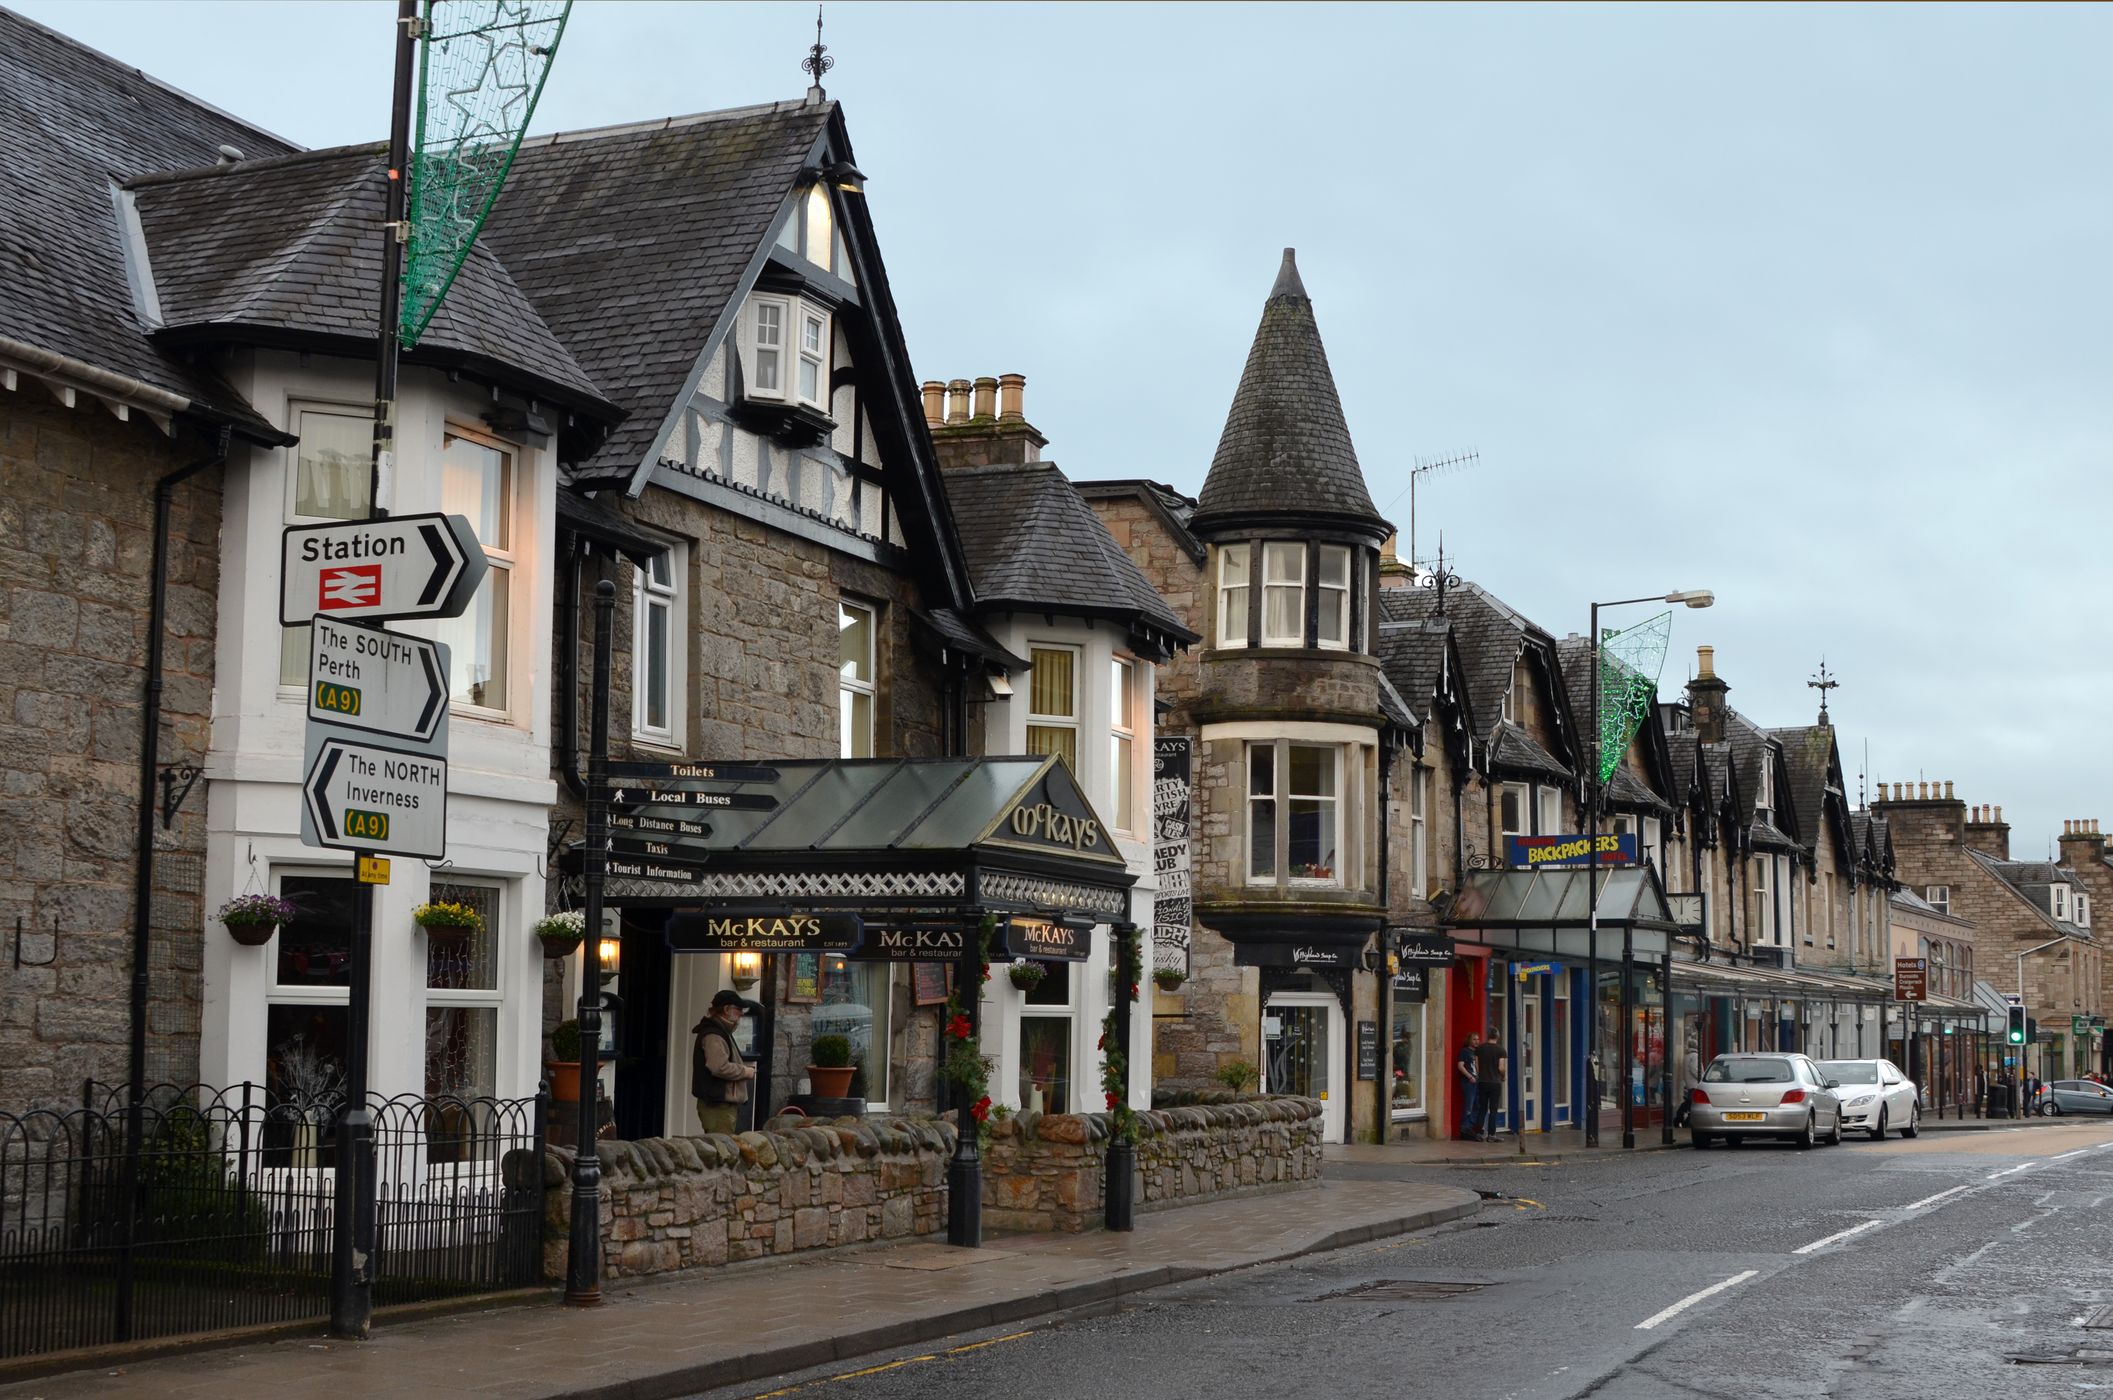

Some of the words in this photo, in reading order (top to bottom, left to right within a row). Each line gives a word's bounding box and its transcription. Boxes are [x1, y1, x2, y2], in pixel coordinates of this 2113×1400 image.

[301, 533, 405, 562] Station
[320, 626, 348, 651] The
[355, 634, 412, 666] SOUTH
[318, 654, 361, 680] Perth
[349, 754, 376, 778] The
[384, 759, 440, 787] NORTH
[670, 764, 714, 778] Toilets
[346, 781, 420, 809] Inverness
[651, 790, 686, 803] Local
[696, 793, 731, 805] Buses
[1154, 801, 1176, 812] YRE
[612, 814, 634, 829] Long
[639, 817, 675, 831] Distance
[680, 822, 702, 834] Buses
[645, 842, 668, 855] Taxis
[612, 862, 641, 875] Tourist
[646, 866, 692, 880] Information
[706, 918, 821, 936] McKAYS
[1024, 924, 1074, 945] McKAYS
[720, 938, 736, 947] bar
[741, 938, 748, 947] &
[750, 938, 805, 947] restaurant
[878, 930, 964, 947] McKAY
[891, 948, 906, 957] bar
[910, 949, 917, 957] &
[1029, 944, 1038, 952] bar
